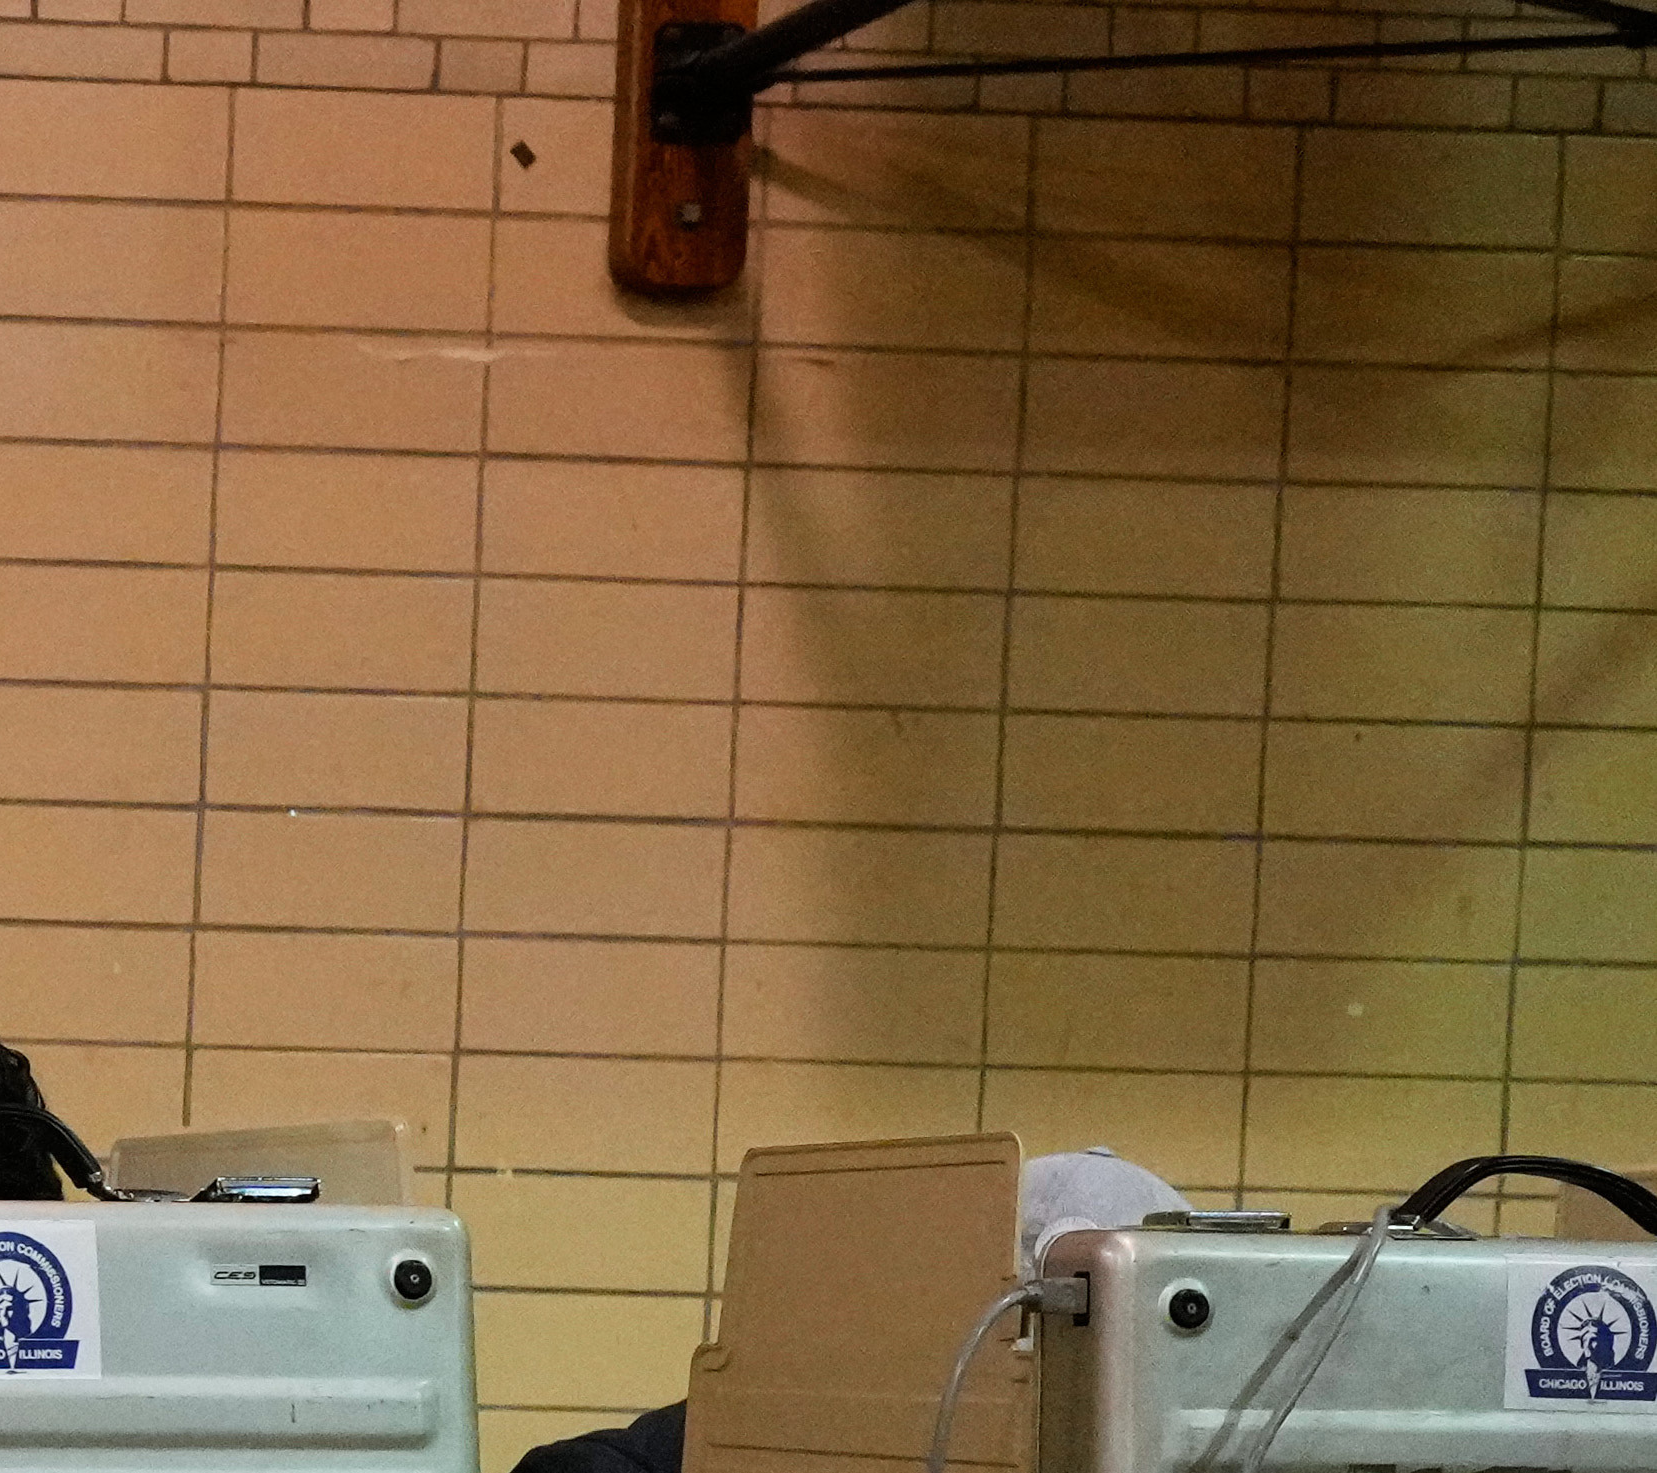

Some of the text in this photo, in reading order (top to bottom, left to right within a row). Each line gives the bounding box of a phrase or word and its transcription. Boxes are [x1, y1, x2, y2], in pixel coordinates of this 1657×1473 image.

[1553, 1273, 1602, 1301] ELECTION
[1544, 1298, 1557, 1315] OF
[1539, 1316, 1555, 1357] BOARD
[18, 1349, 63, 1360] ILLINOIS
[1538, 1378, 1645, 1392] CHICAGO ILLINOIS
